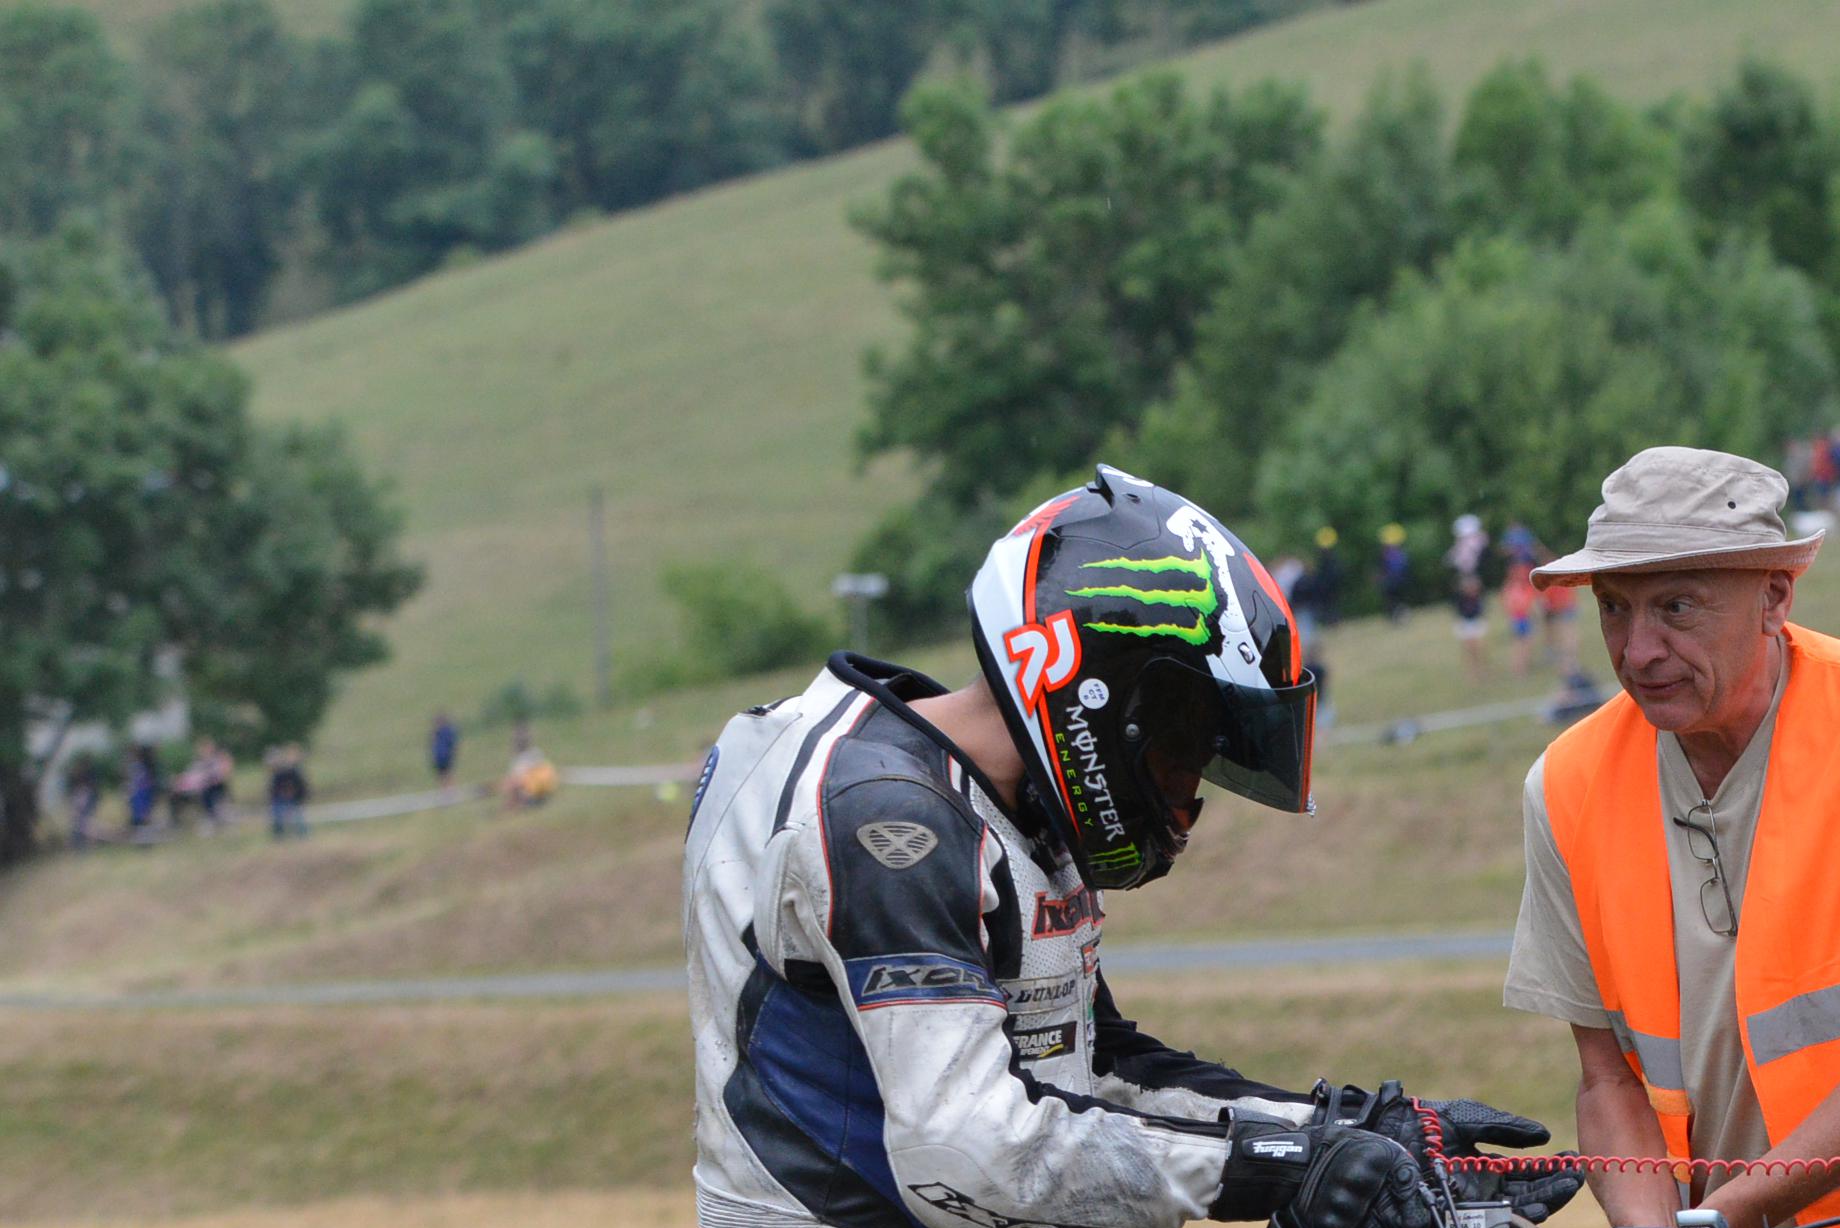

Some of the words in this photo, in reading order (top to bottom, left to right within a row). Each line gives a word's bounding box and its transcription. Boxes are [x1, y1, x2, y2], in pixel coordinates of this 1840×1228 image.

[1055, 732, 1094, 827] ENERGY
[1065, 704, 1125, 843] MONSTER
[1015, 979, 1076, 1004] DUNLOP
